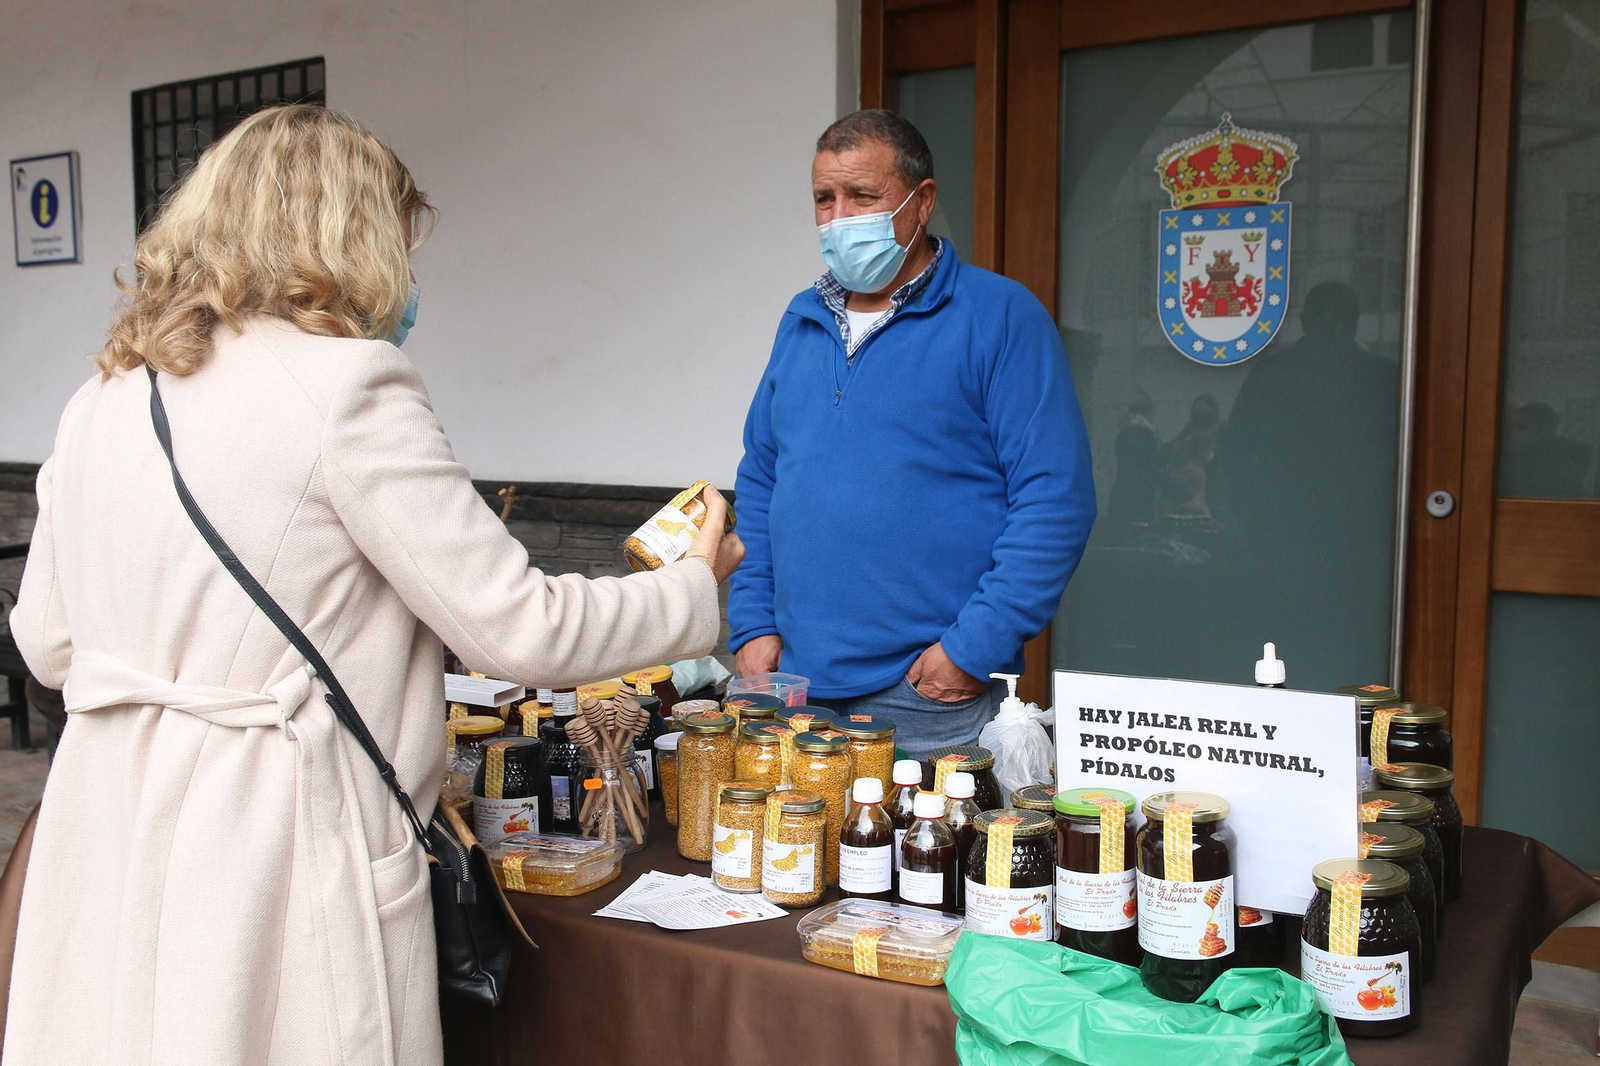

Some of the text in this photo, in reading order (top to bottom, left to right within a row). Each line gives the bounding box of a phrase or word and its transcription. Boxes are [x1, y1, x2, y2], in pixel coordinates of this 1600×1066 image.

[1188, 243, 1260, 266] F Y
[1079, 707, 1277, 740] HAY JALEA REAL Y
[1080, 733, 1324, 778] PROPÓLEO NATURAL,
[1081, 757, 1175, 783] PÍDALOS
[1147, 876, 1156, 889] de
[1158, 881, 1167, 892] la
[1171, 882, 1204, 894] Sierra
[1156, 901, 1177, 912] Prado
[1325, 967, 1347, 978] Prado
[1354, 963, 1382, 971] Filabres
